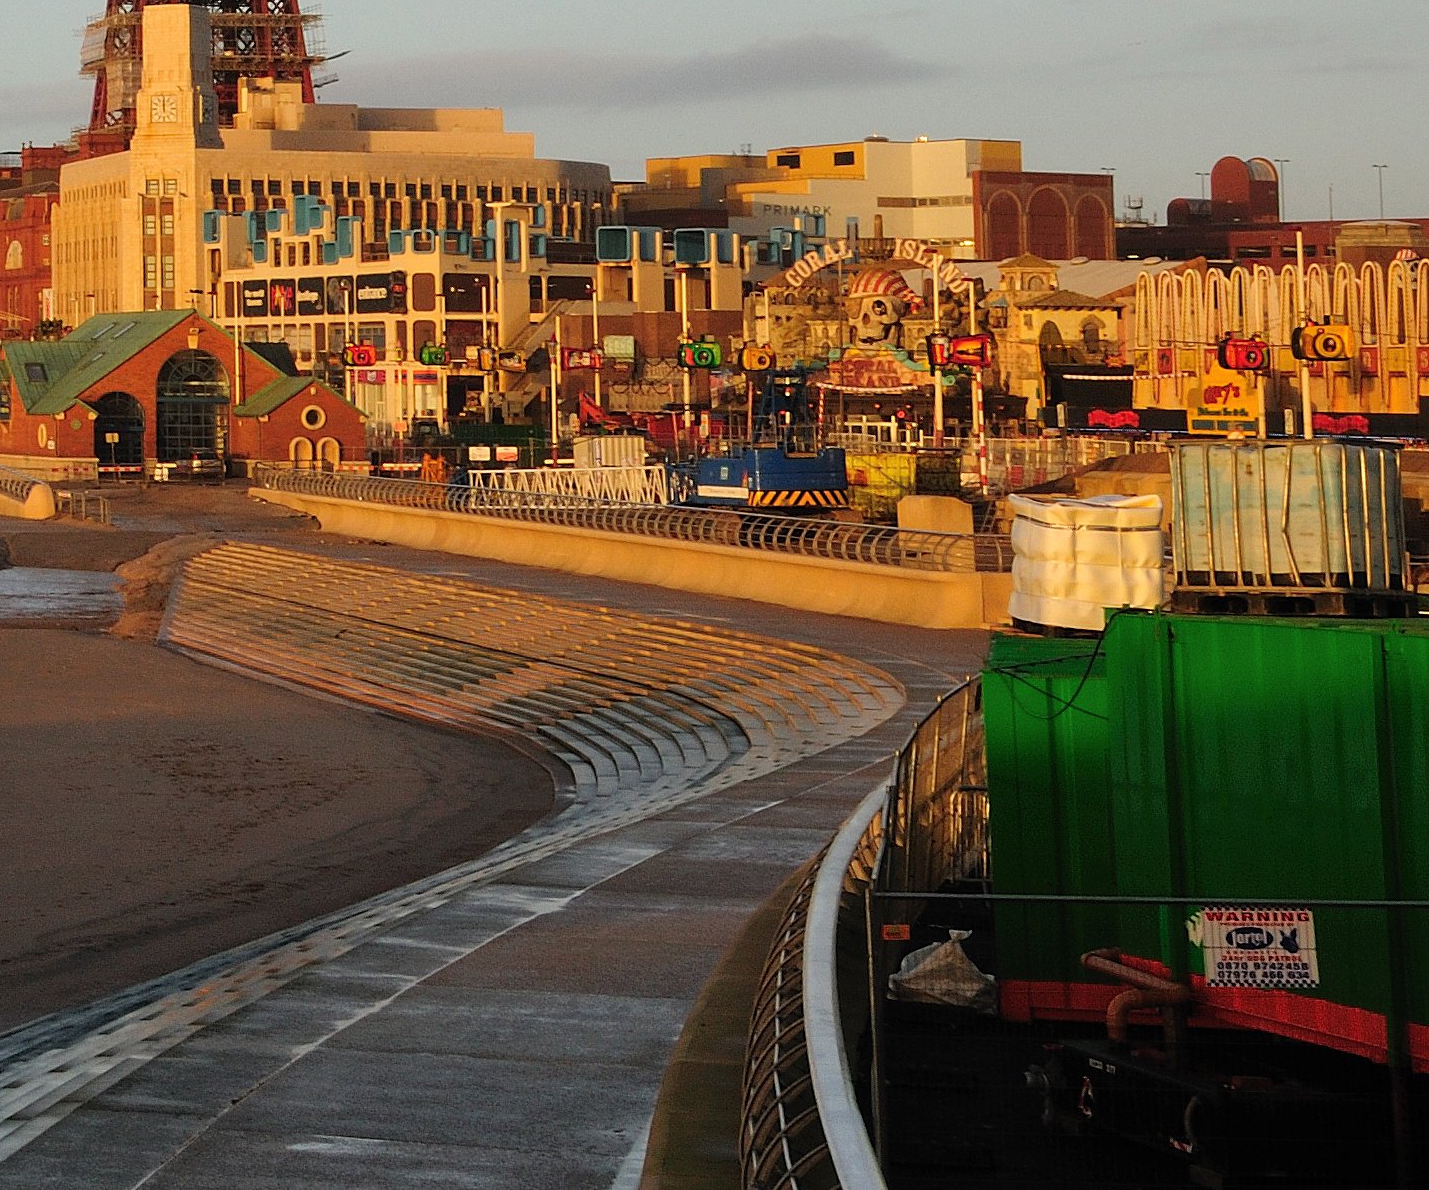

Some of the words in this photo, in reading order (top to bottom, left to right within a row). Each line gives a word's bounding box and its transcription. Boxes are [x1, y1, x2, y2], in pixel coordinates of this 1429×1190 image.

[764, 205, 832, 217] PRIMARK
[784, 237, 853, 288] CORAL
[893, 237, 970, 294] ISLAND
[1205, 912, 1310, 922] WARNING
[1217, 962, 1249, 970] 0870
